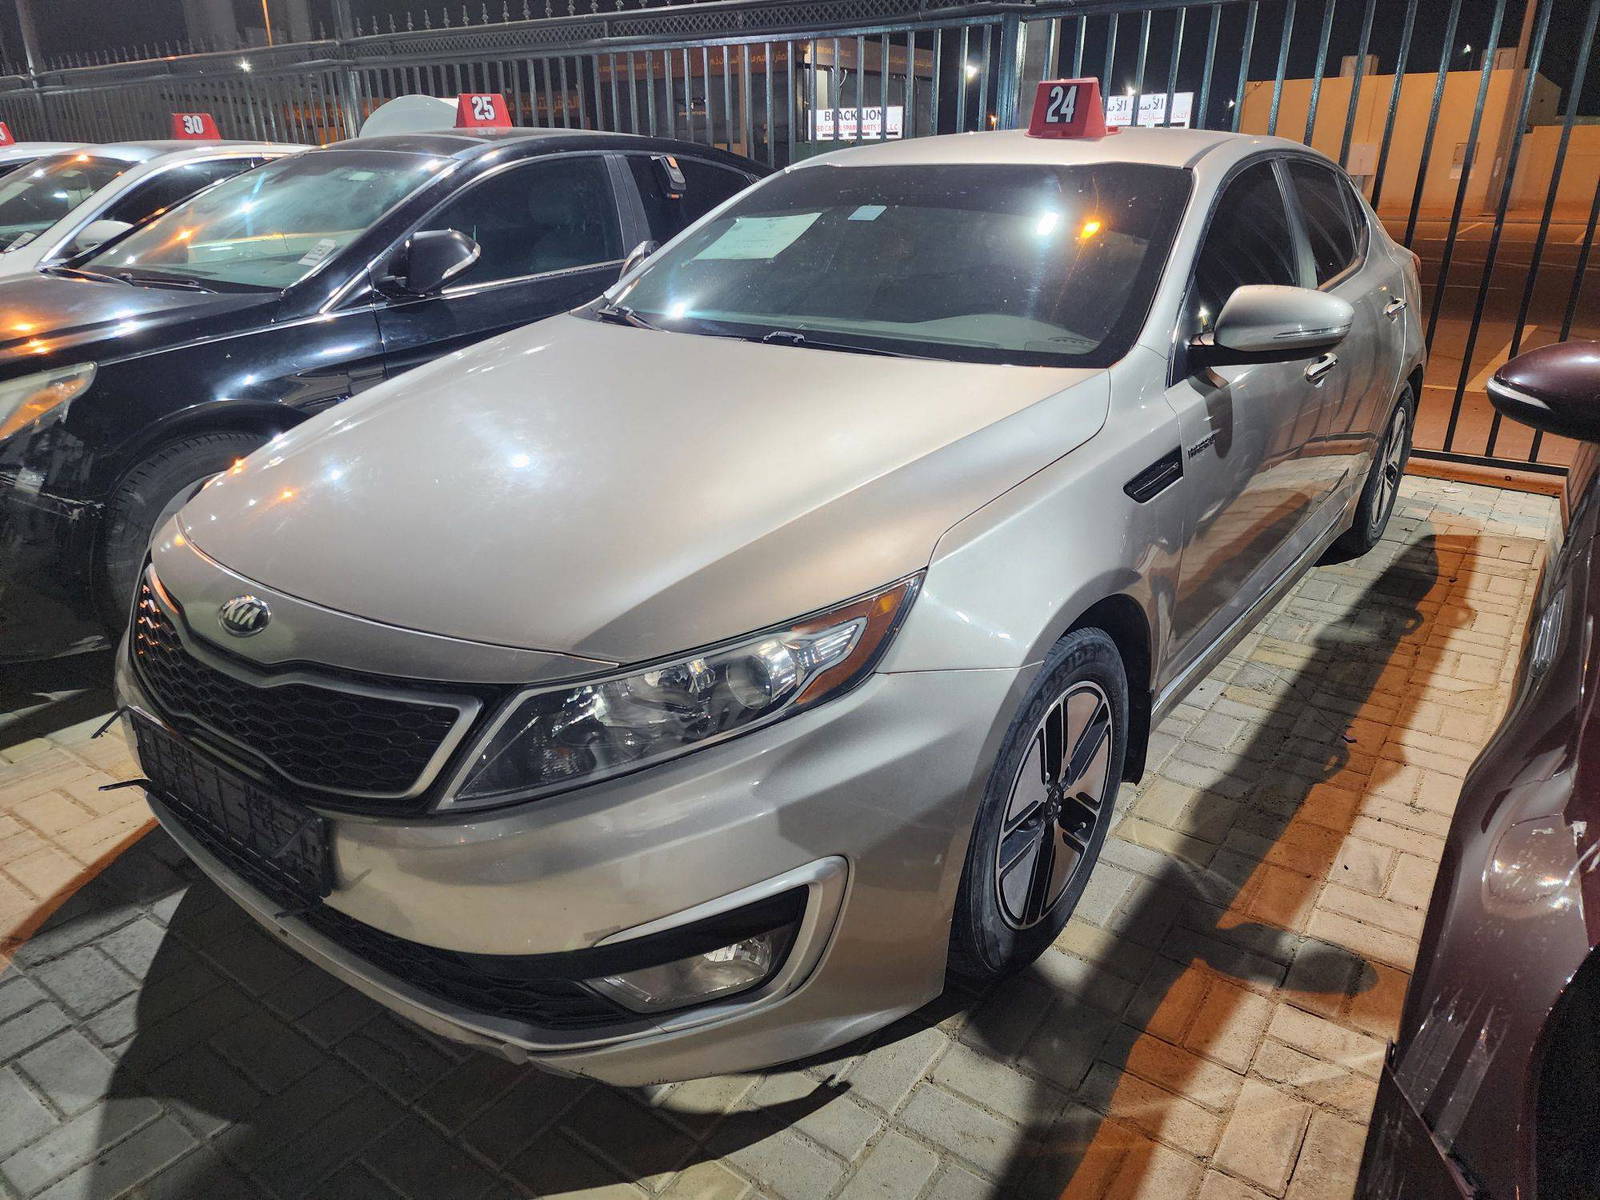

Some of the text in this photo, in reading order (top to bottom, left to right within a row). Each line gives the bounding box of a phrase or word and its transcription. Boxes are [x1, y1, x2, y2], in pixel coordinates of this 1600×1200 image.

[471, 96, 496, 121] 25
[1045, 85, 1078, 124] 24
[182, 115, 204, 135] 30
[222, 600, 262, 629] KIA
